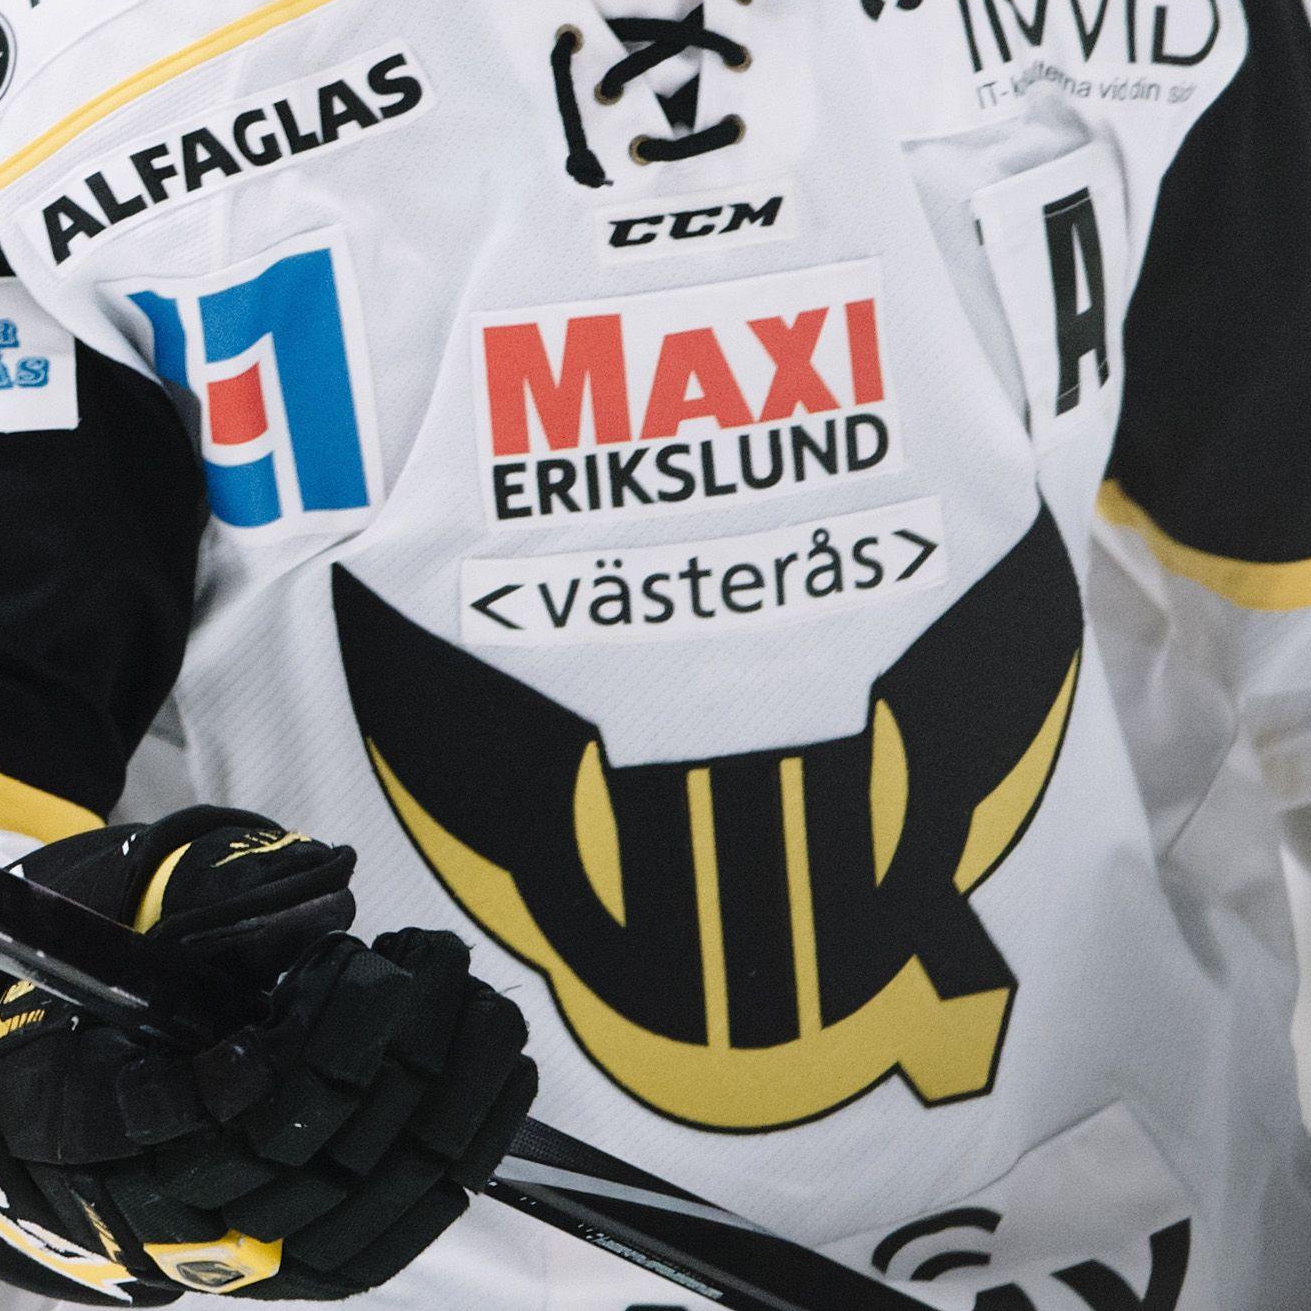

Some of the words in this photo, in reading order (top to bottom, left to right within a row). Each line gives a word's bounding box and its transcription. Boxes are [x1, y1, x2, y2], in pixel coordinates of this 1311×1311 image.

[40, 53, 424, 266] ALFAGLAS
[607, 196, 784, 248] CCM
[483, 297, 885, 457] MAXI
[1043, 186, 1110, 417] A
[492, 412, 890, 521] ERIKSLUND
